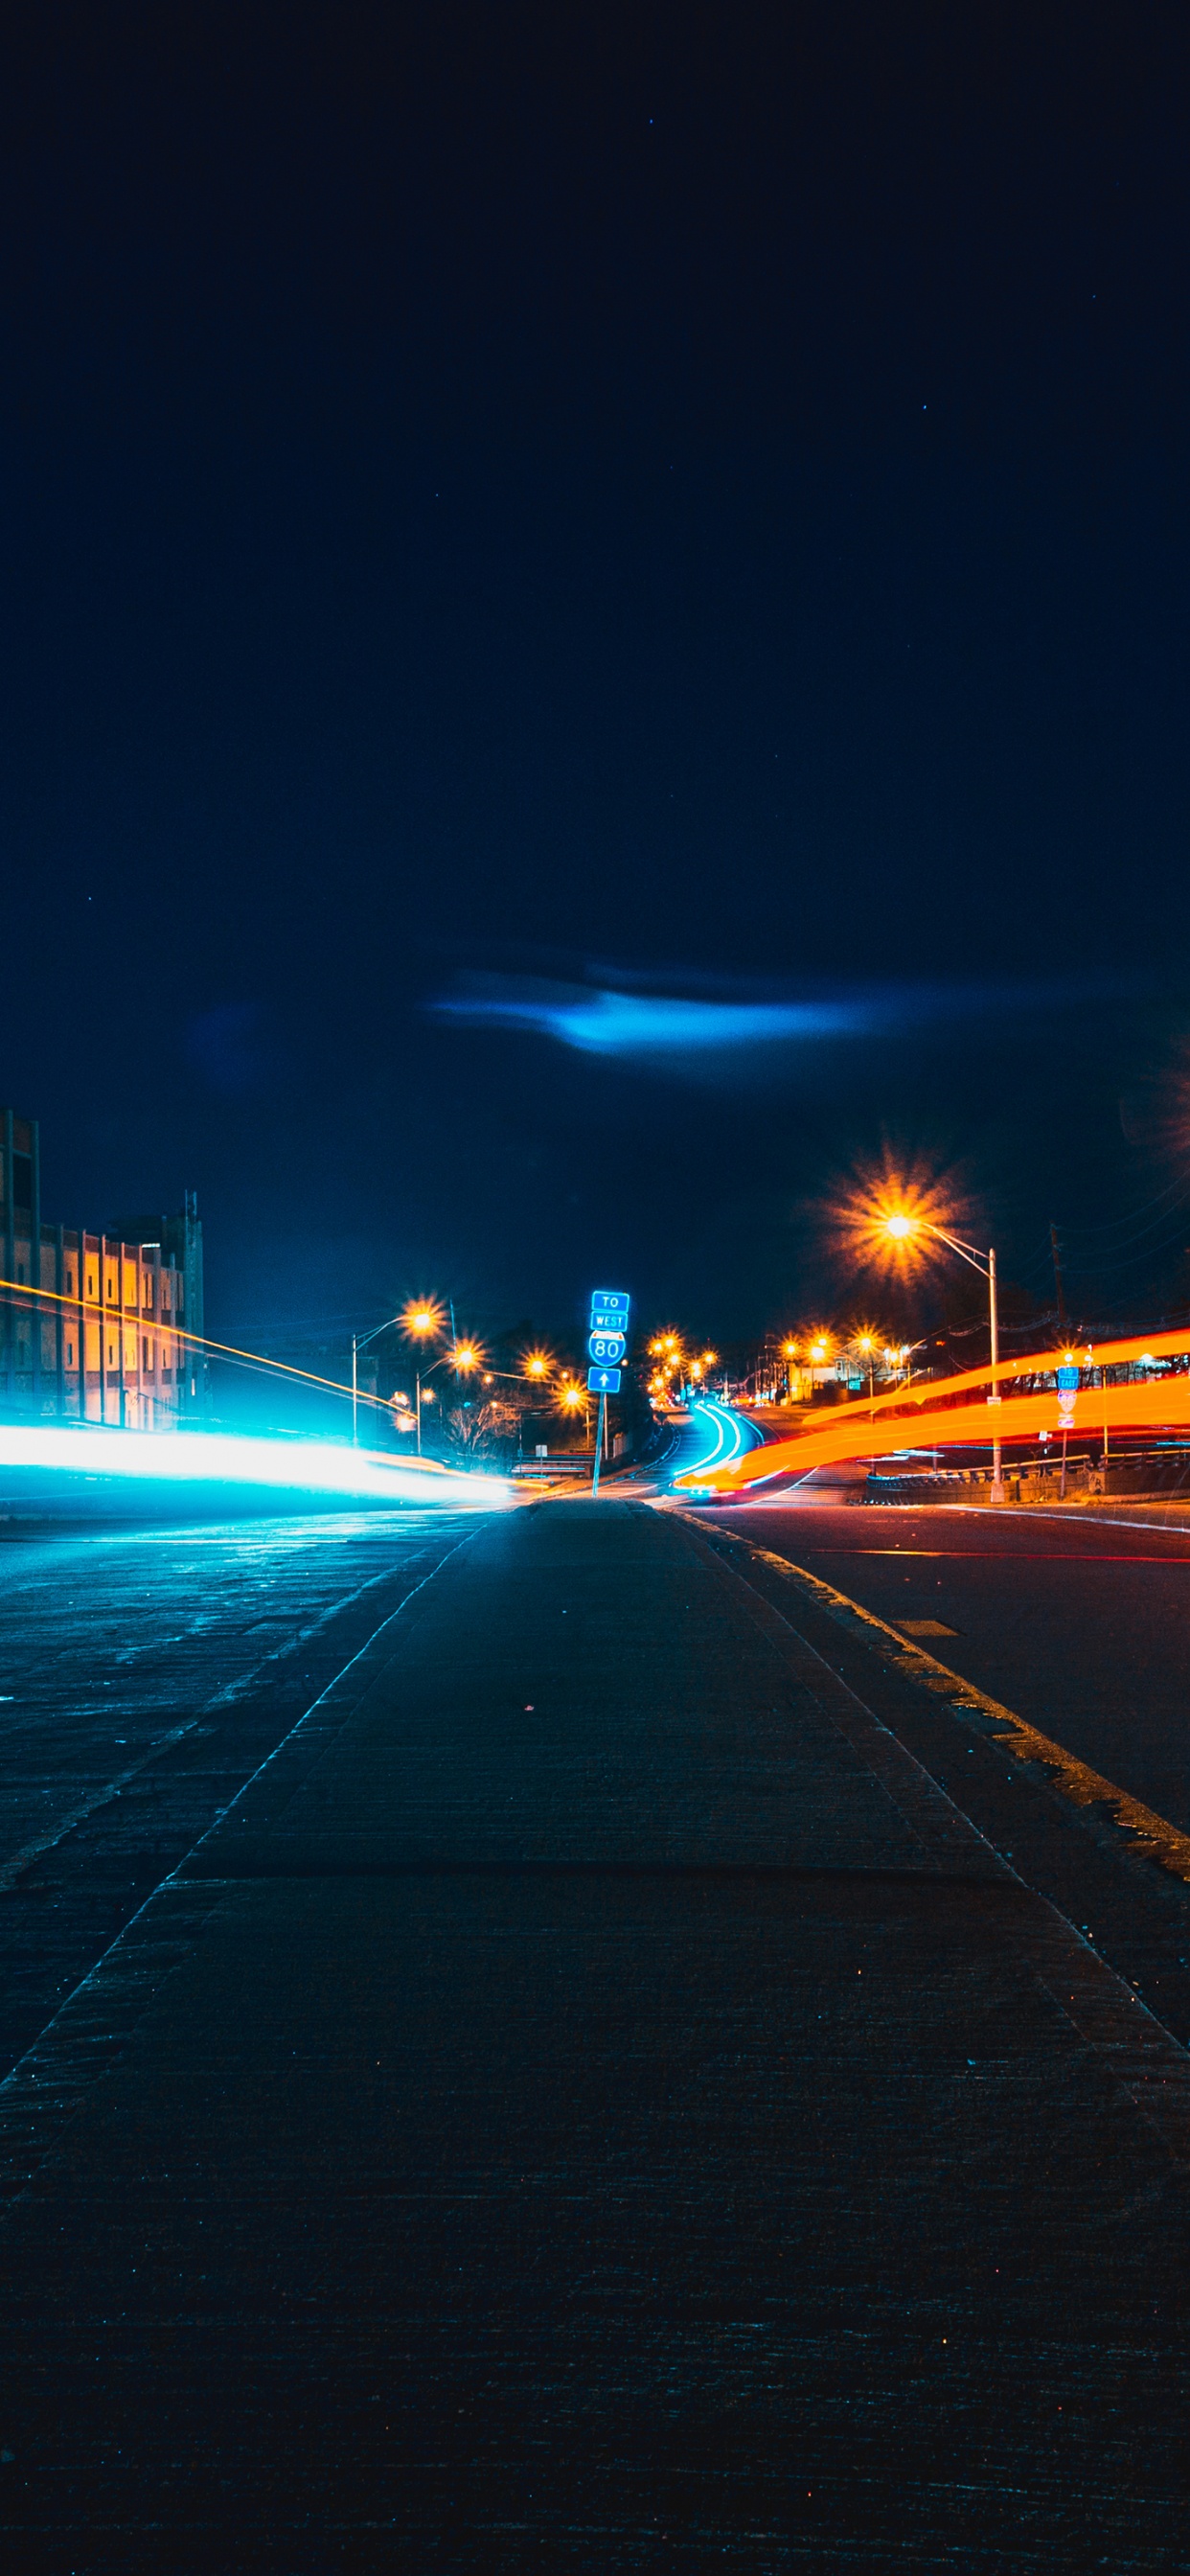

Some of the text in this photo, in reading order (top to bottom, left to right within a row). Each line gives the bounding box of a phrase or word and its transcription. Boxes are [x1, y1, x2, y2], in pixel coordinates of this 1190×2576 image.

[603, 1296, 619, 1308] TO
[596, 1316, 623, 1328] WEST
[595, 1341, 619, 1358] 80
